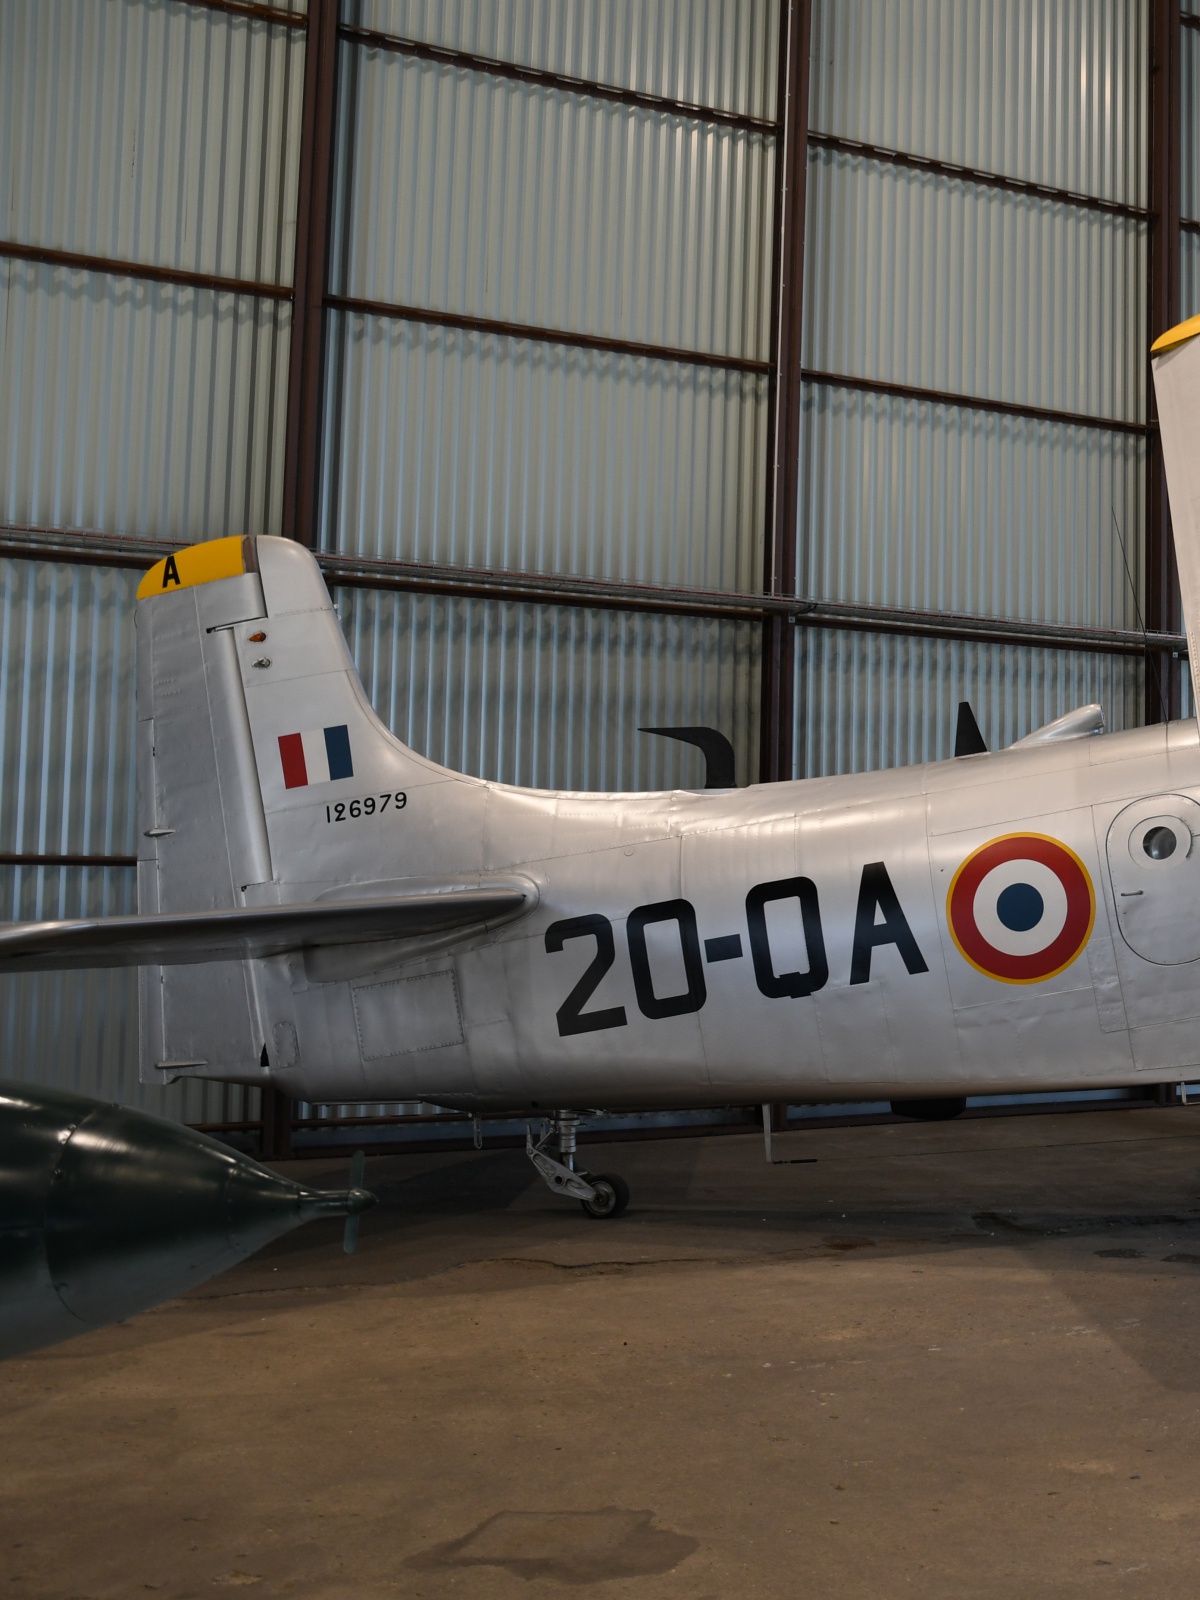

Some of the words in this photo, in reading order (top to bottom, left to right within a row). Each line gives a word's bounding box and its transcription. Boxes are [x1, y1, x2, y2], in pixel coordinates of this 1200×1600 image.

[162, 555, 181, 588] A
[326, 792, 407, 823] 126979
[544, 861, 930, 1037] 20-QA
